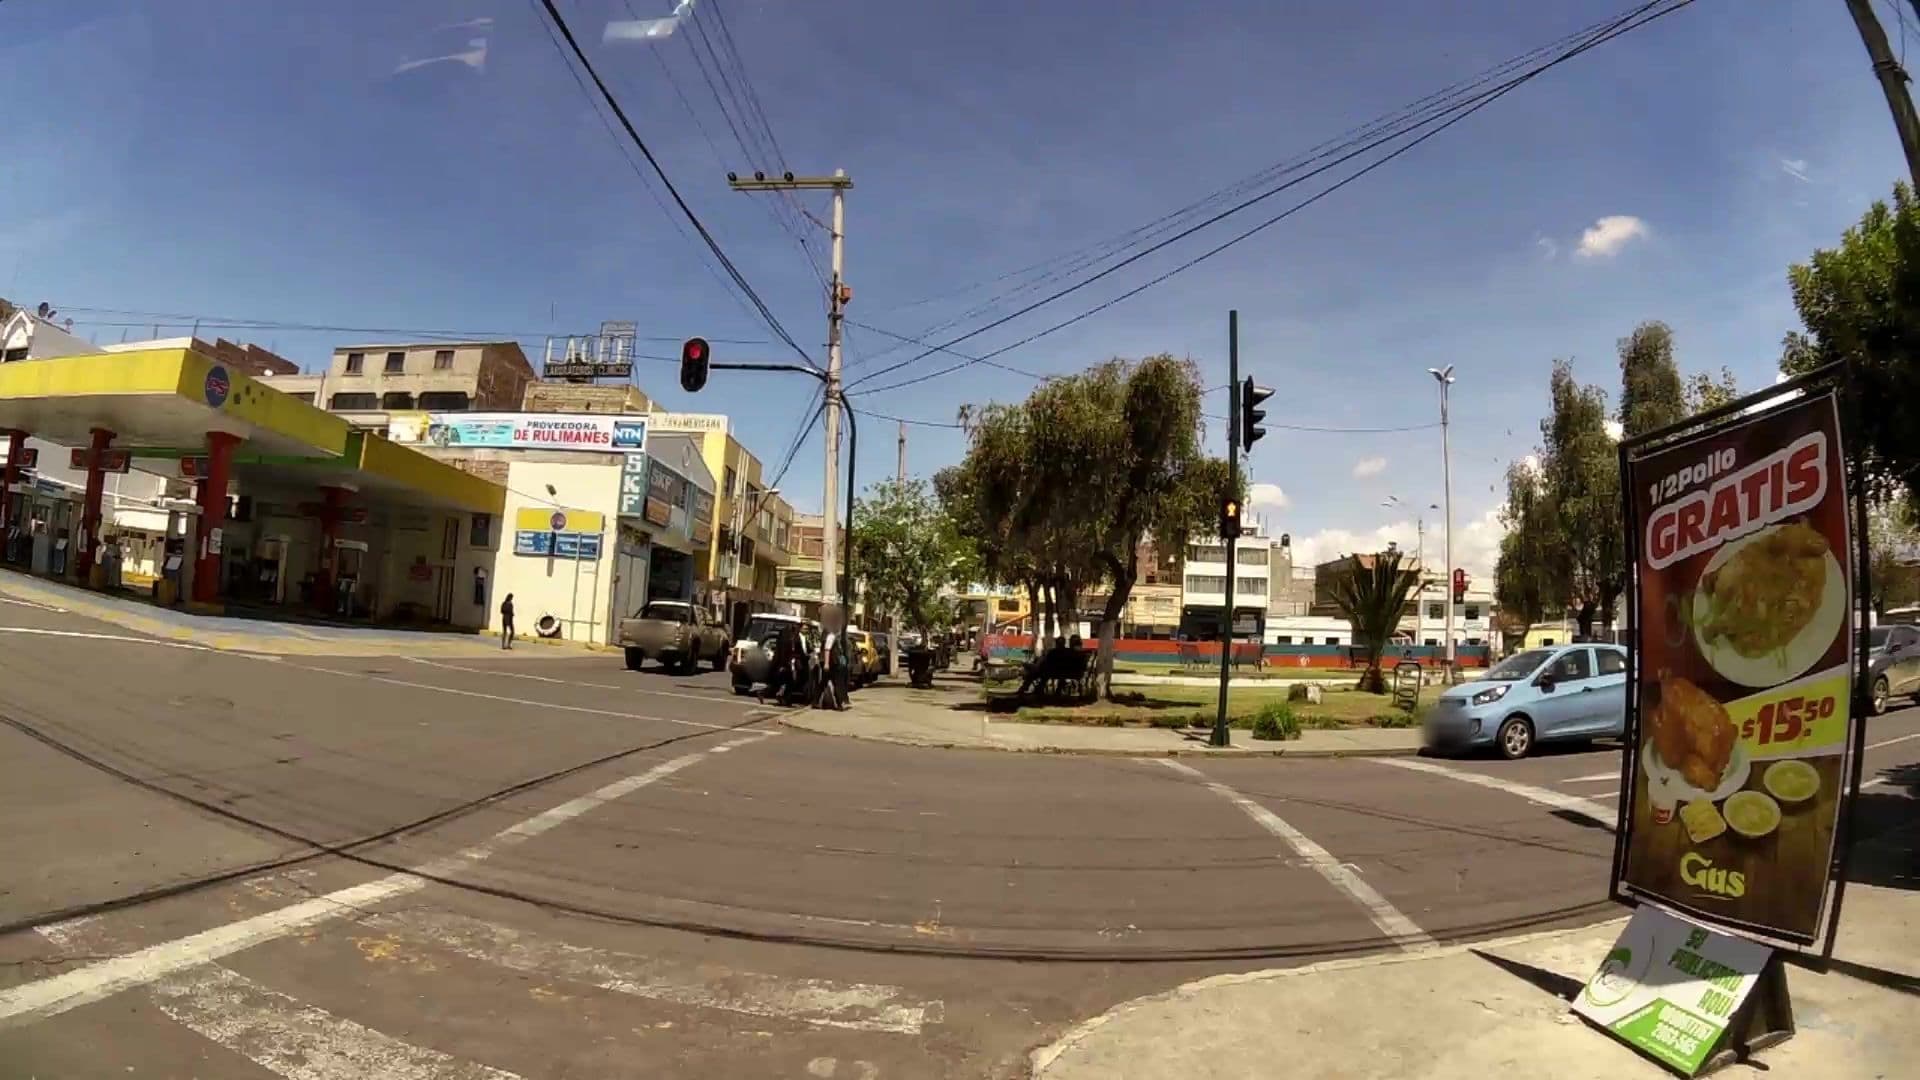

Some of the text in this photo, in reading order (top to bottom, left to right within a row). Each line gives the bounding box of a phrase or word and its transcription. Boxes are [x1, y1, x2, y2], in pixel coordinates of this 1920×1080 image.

[527, 420, 598, 431] PROVEEDORA
[513, 429, 529, 441] DE
[533, 429, 610, 444] RULIMANES
[614, 427, 641, 441] NTN
[623, 455, 641, 512] SKF
[1647, 435, 1825, 566] GRATIS
